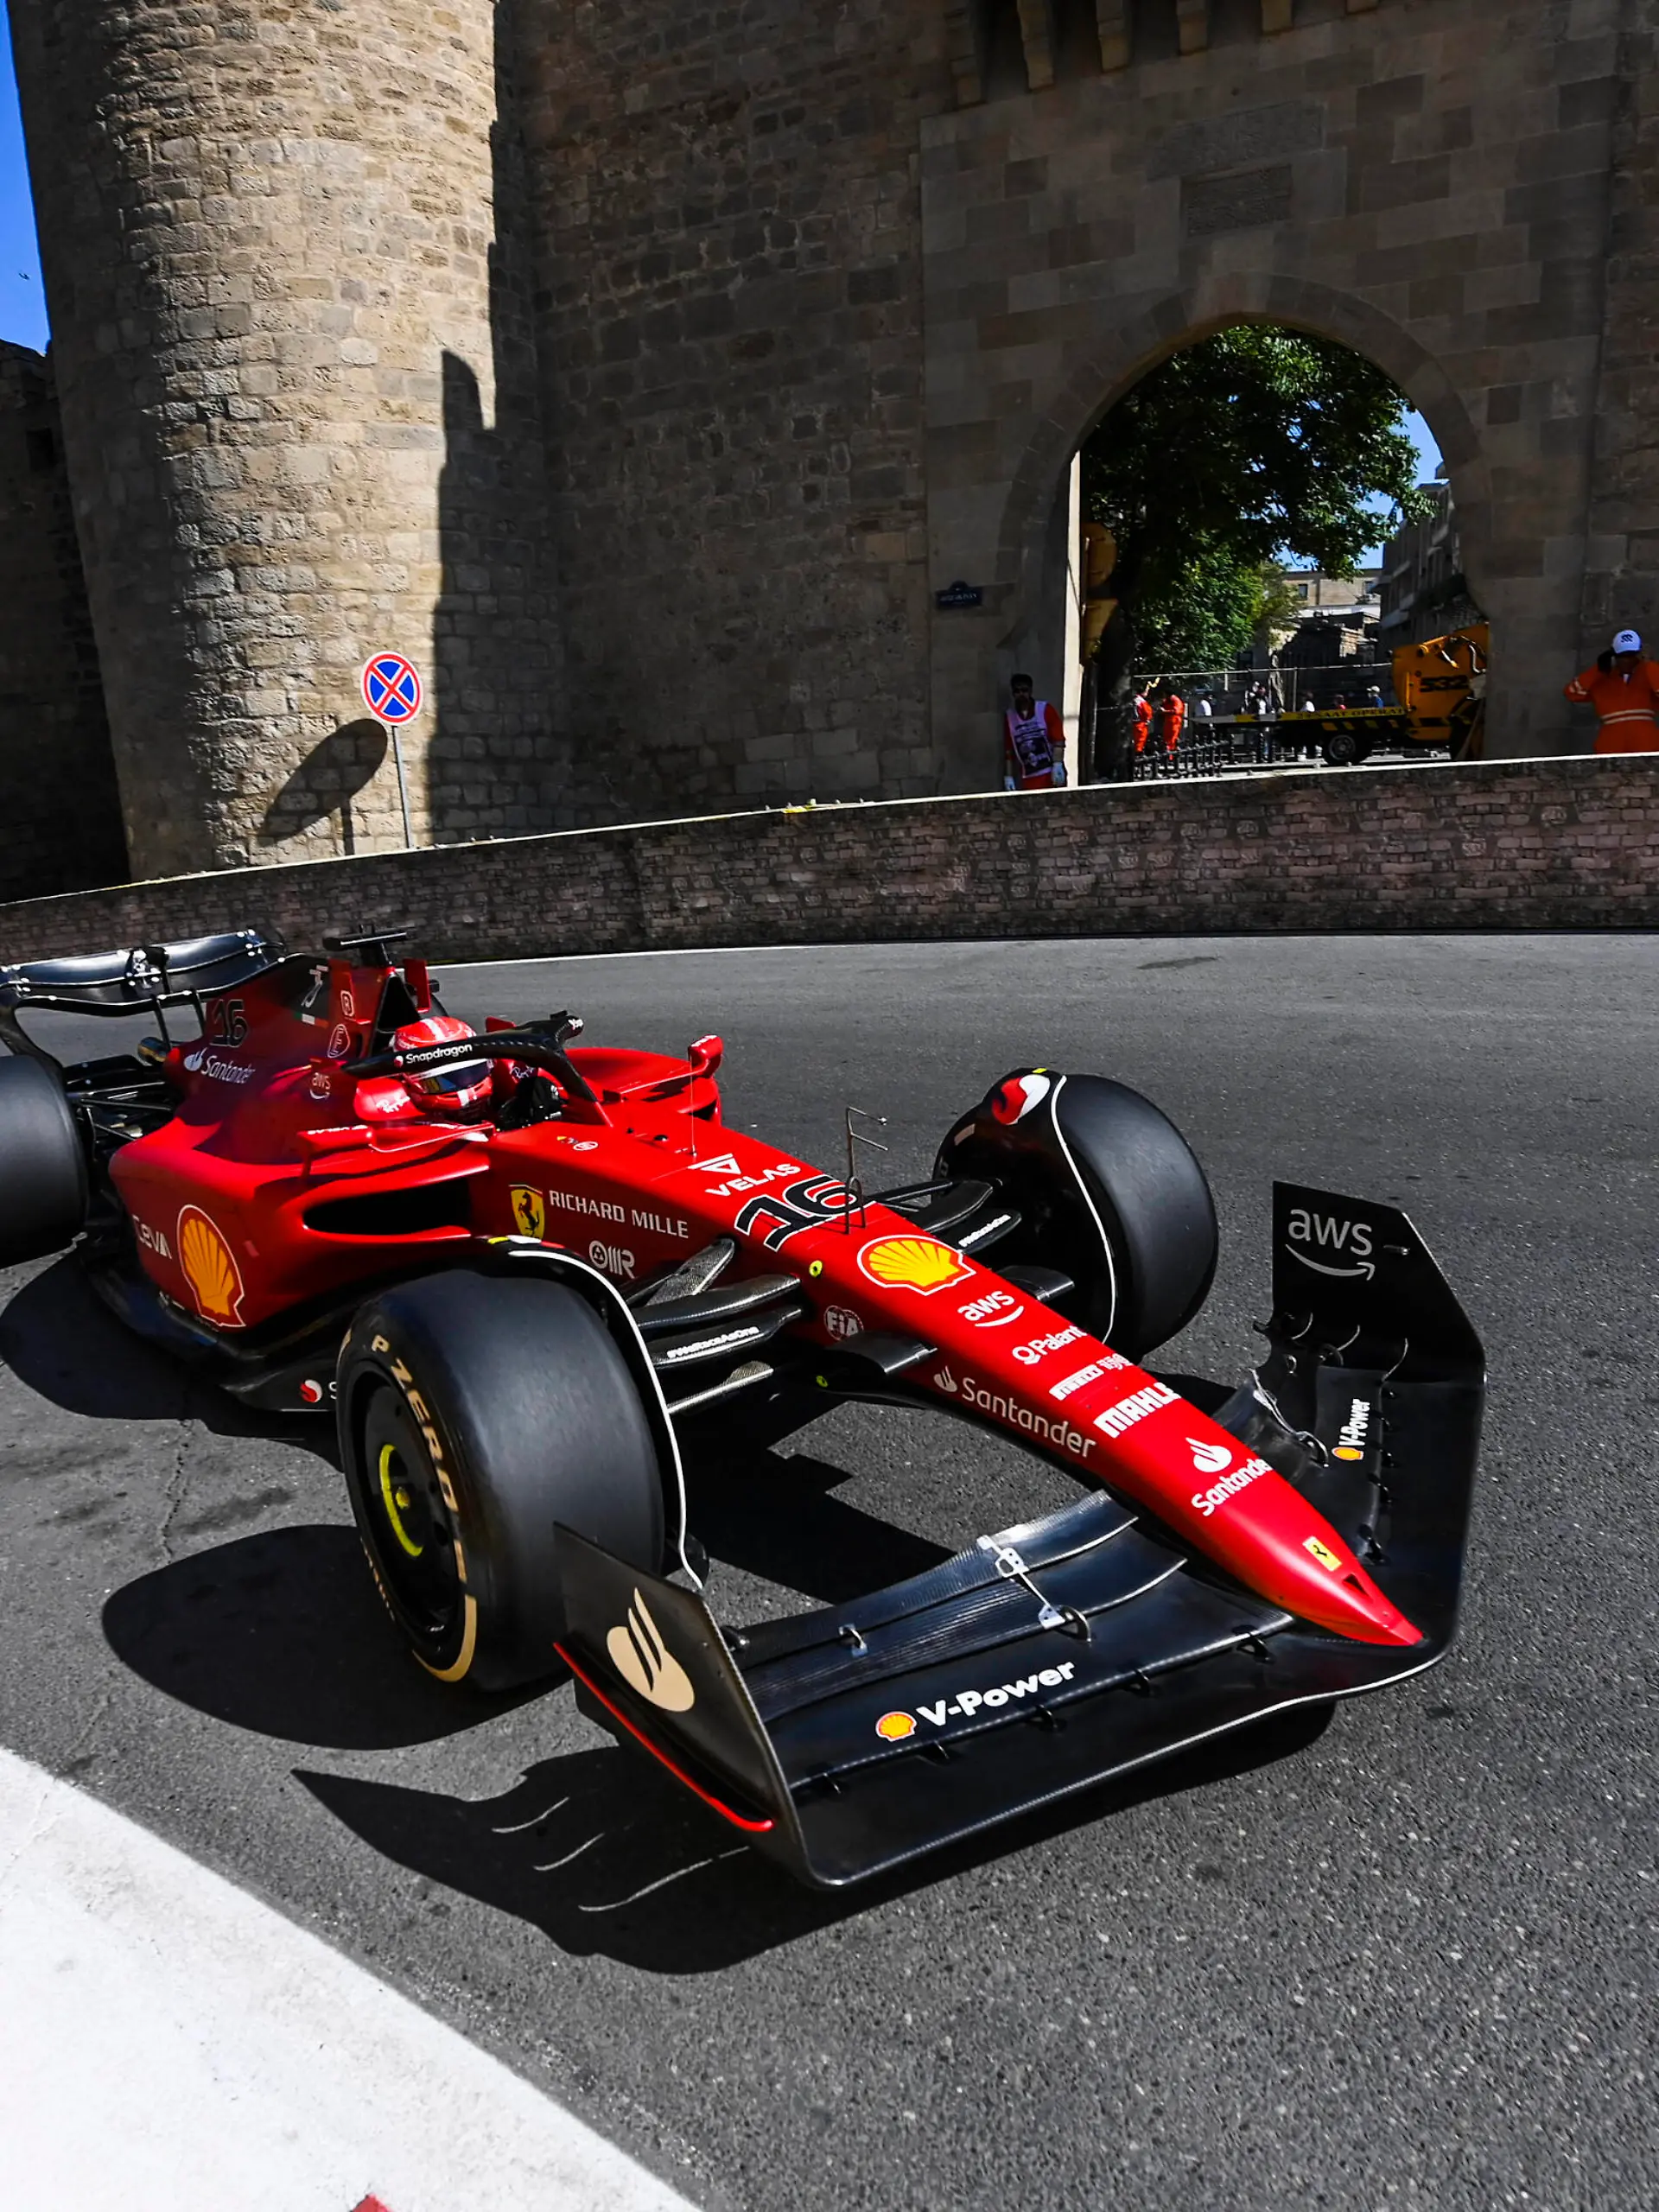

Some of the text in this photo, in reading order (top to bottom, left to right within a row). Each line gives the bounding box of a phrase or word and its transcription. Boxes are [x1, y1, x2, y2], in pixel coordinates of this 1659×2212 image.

[209, 999, 249, 1048] 16
[405, 1044, 473, 1064] Snapdragon
[704, 1163, 801, 1197] VELAS
[550, 1190, 689, 1239] RICHARD MILLE
[734, 1173, 866, 1252] 16
[1287, 1209, 1373, 1255] aws
[957, 1290, 1015, 1321] aws
[1028, 1325, 1088, 1357] Palant
[1049, 1364, 1104, 1401] PIRELLI
[372, 1334, 459, 1511] P ZERO
[962, 1377, 1096, 1458] Santander
[1338, 1398, 1370, 1446] V-Power
[1192, 1458, 1274, 1516] Santande
[916, 1662, 1075, 1726] V-Power
